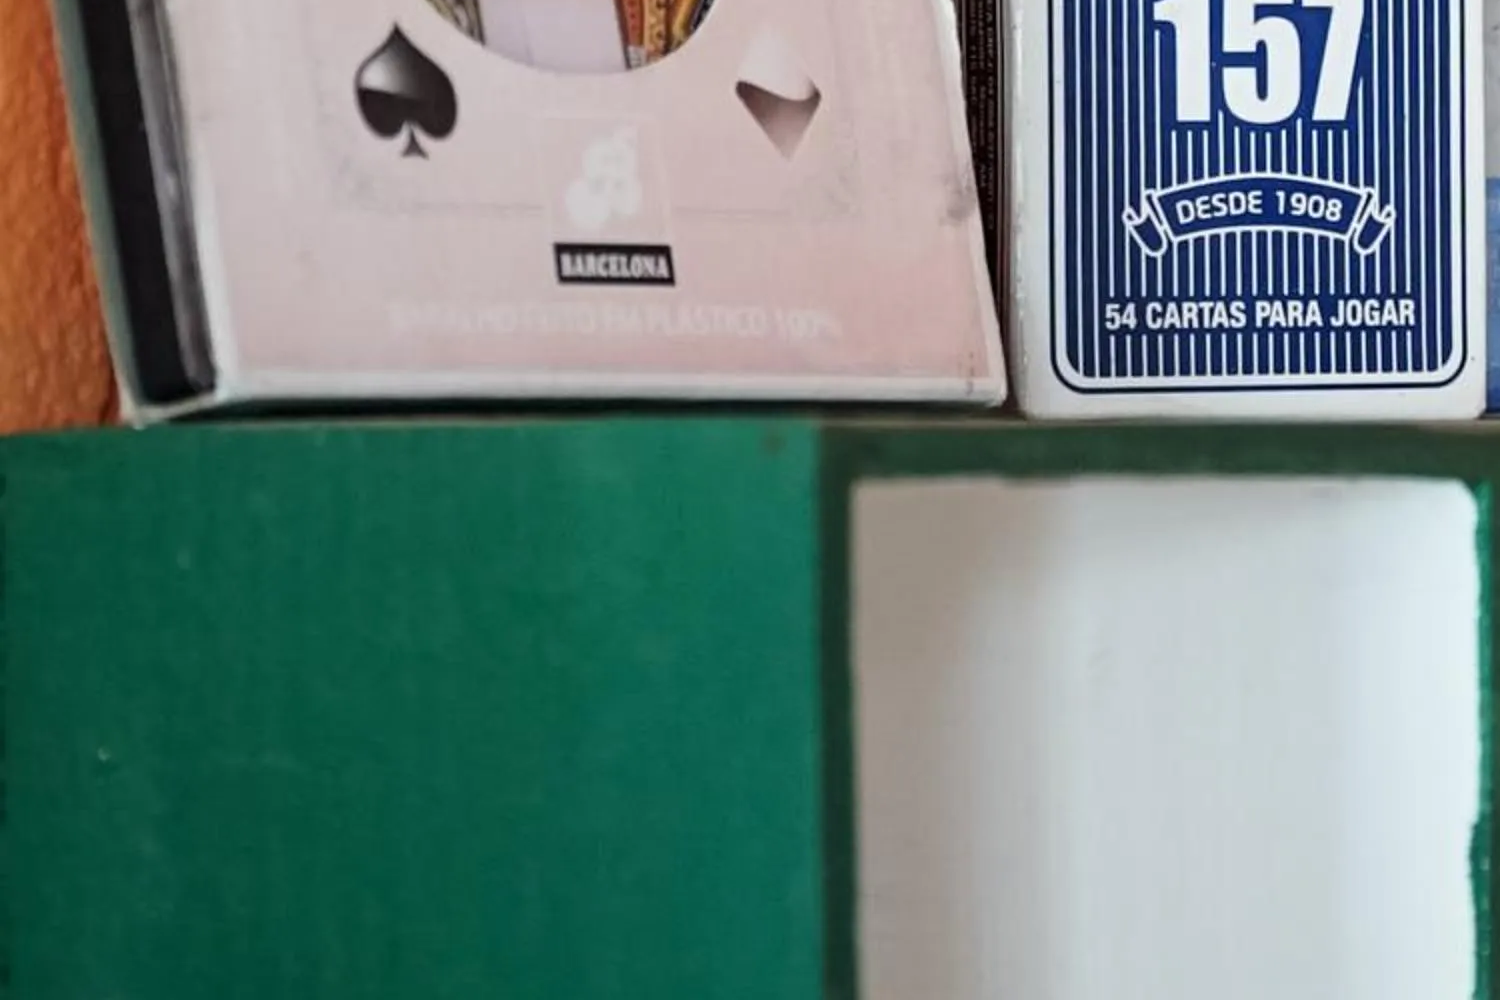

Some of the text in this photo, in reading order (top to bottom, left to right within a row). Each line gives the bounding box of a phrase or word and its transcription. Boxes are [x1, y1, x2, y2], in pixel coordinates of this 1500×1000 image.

[1175, 190, 1343, 225] DESDE 1908
[559, 251, 671, 279] BARCELONA
[1105, 298, 1416, 329] 54 CARTAS PARA JOGAR
